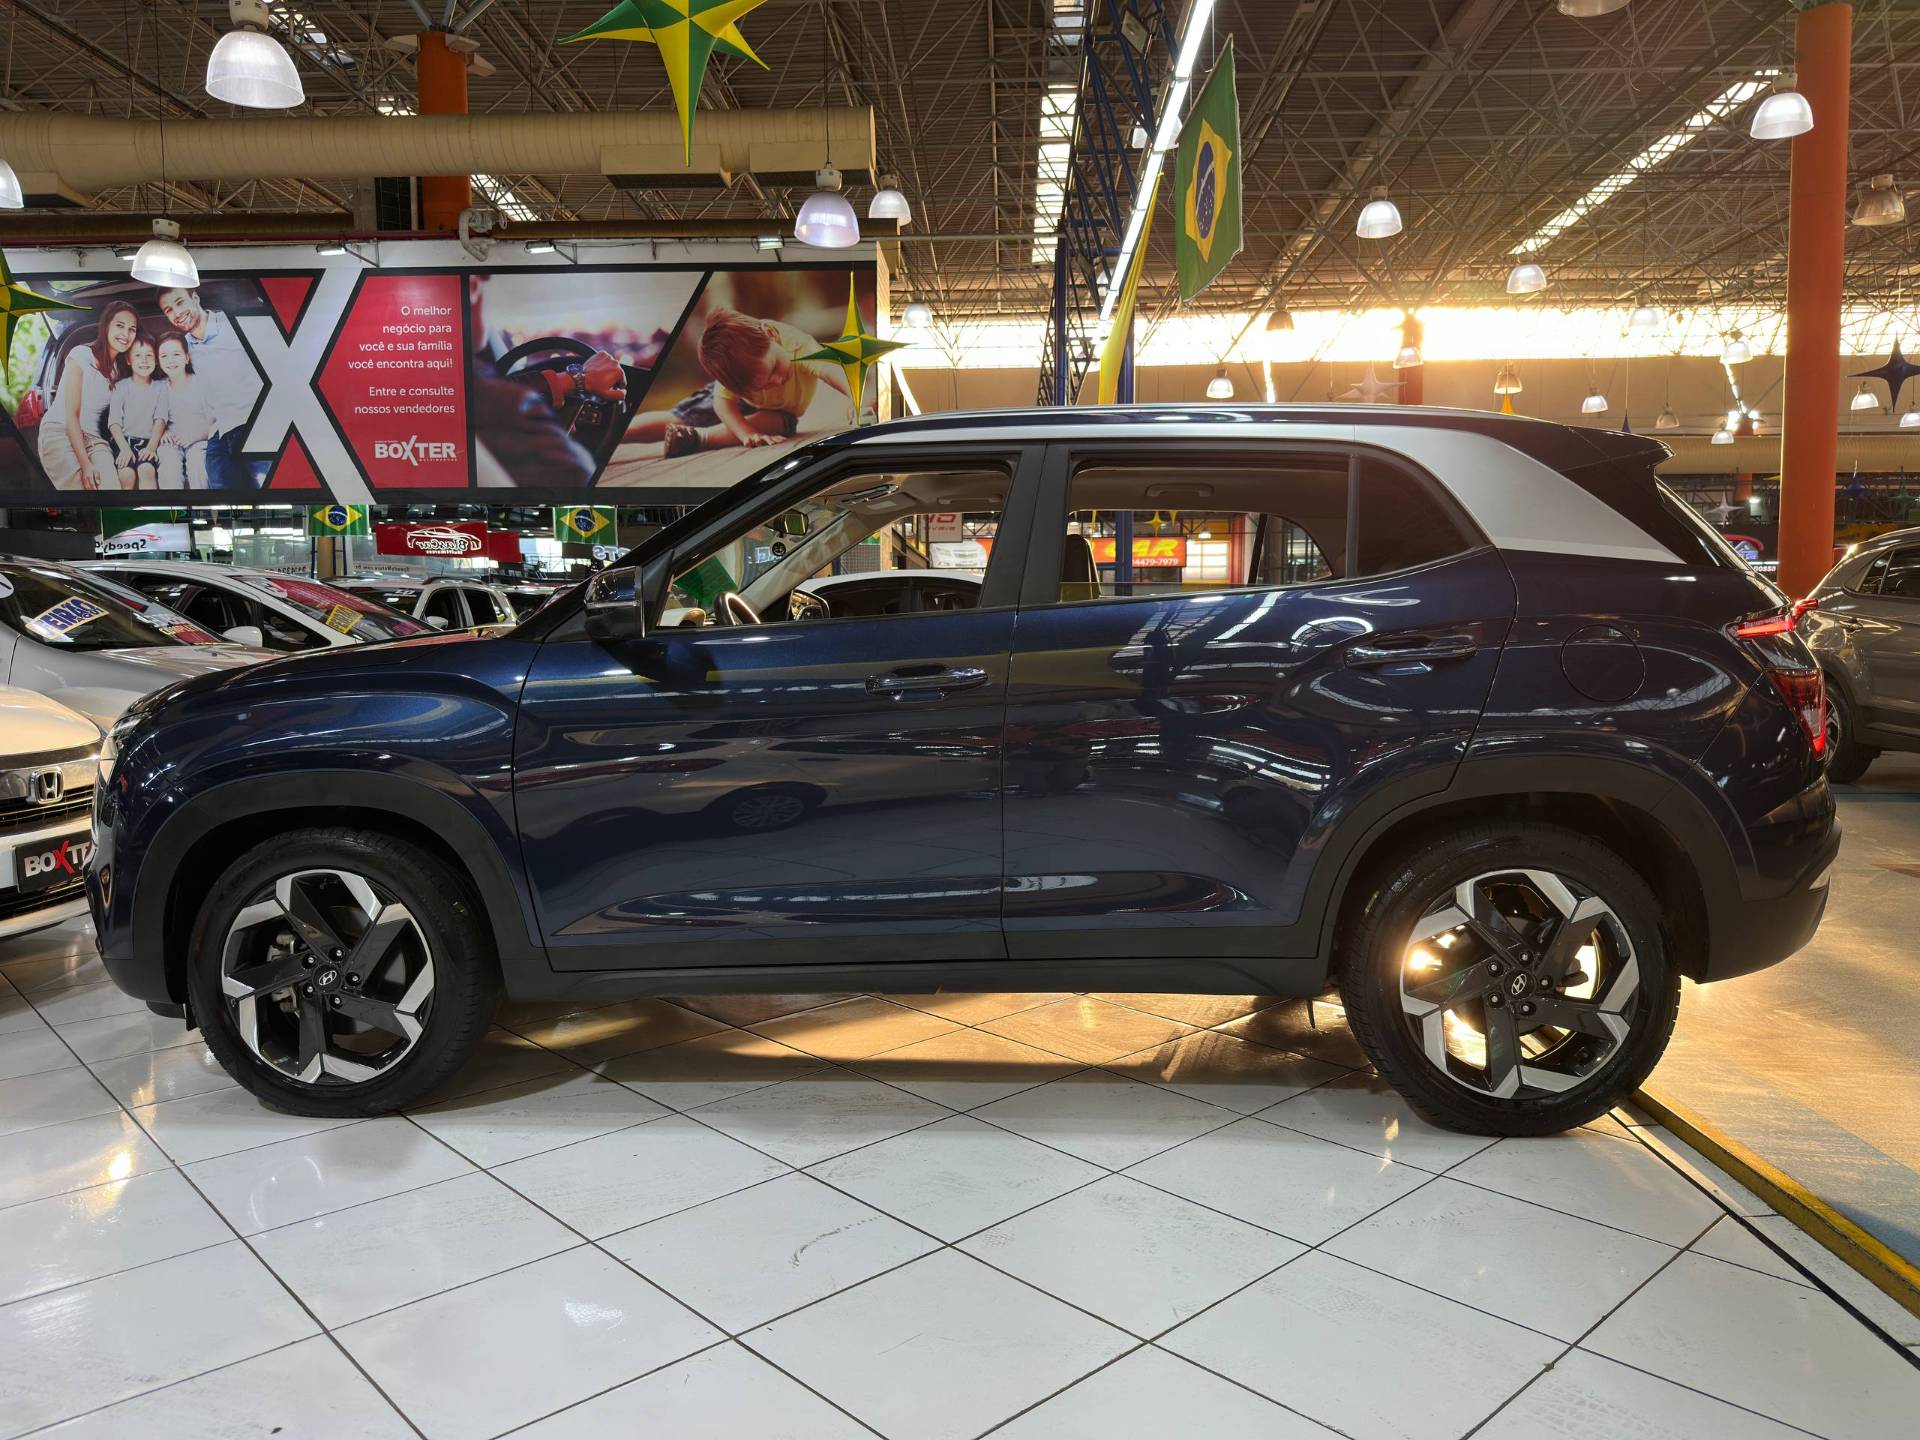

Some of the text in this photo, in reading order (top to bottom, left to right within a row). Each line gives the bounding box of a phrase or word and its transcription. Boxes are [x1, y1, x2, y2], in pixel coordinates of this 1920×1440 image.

[401, 306, 452, 316] O melhor
[383, 324, 452, 335] negócio para
[359, 341, 385, 352] você
[387, 343, 394, 351] e
[396, 343, 415, 351] sua
[348, 358, 453, 371] você encontra aqui!
[369, 386, 397, 396] Entre
[408, 386, 455, 396] consulte
[354, 404, 455, 414] nossos vendedores
[374, 435, 457, 466] BOXTER
